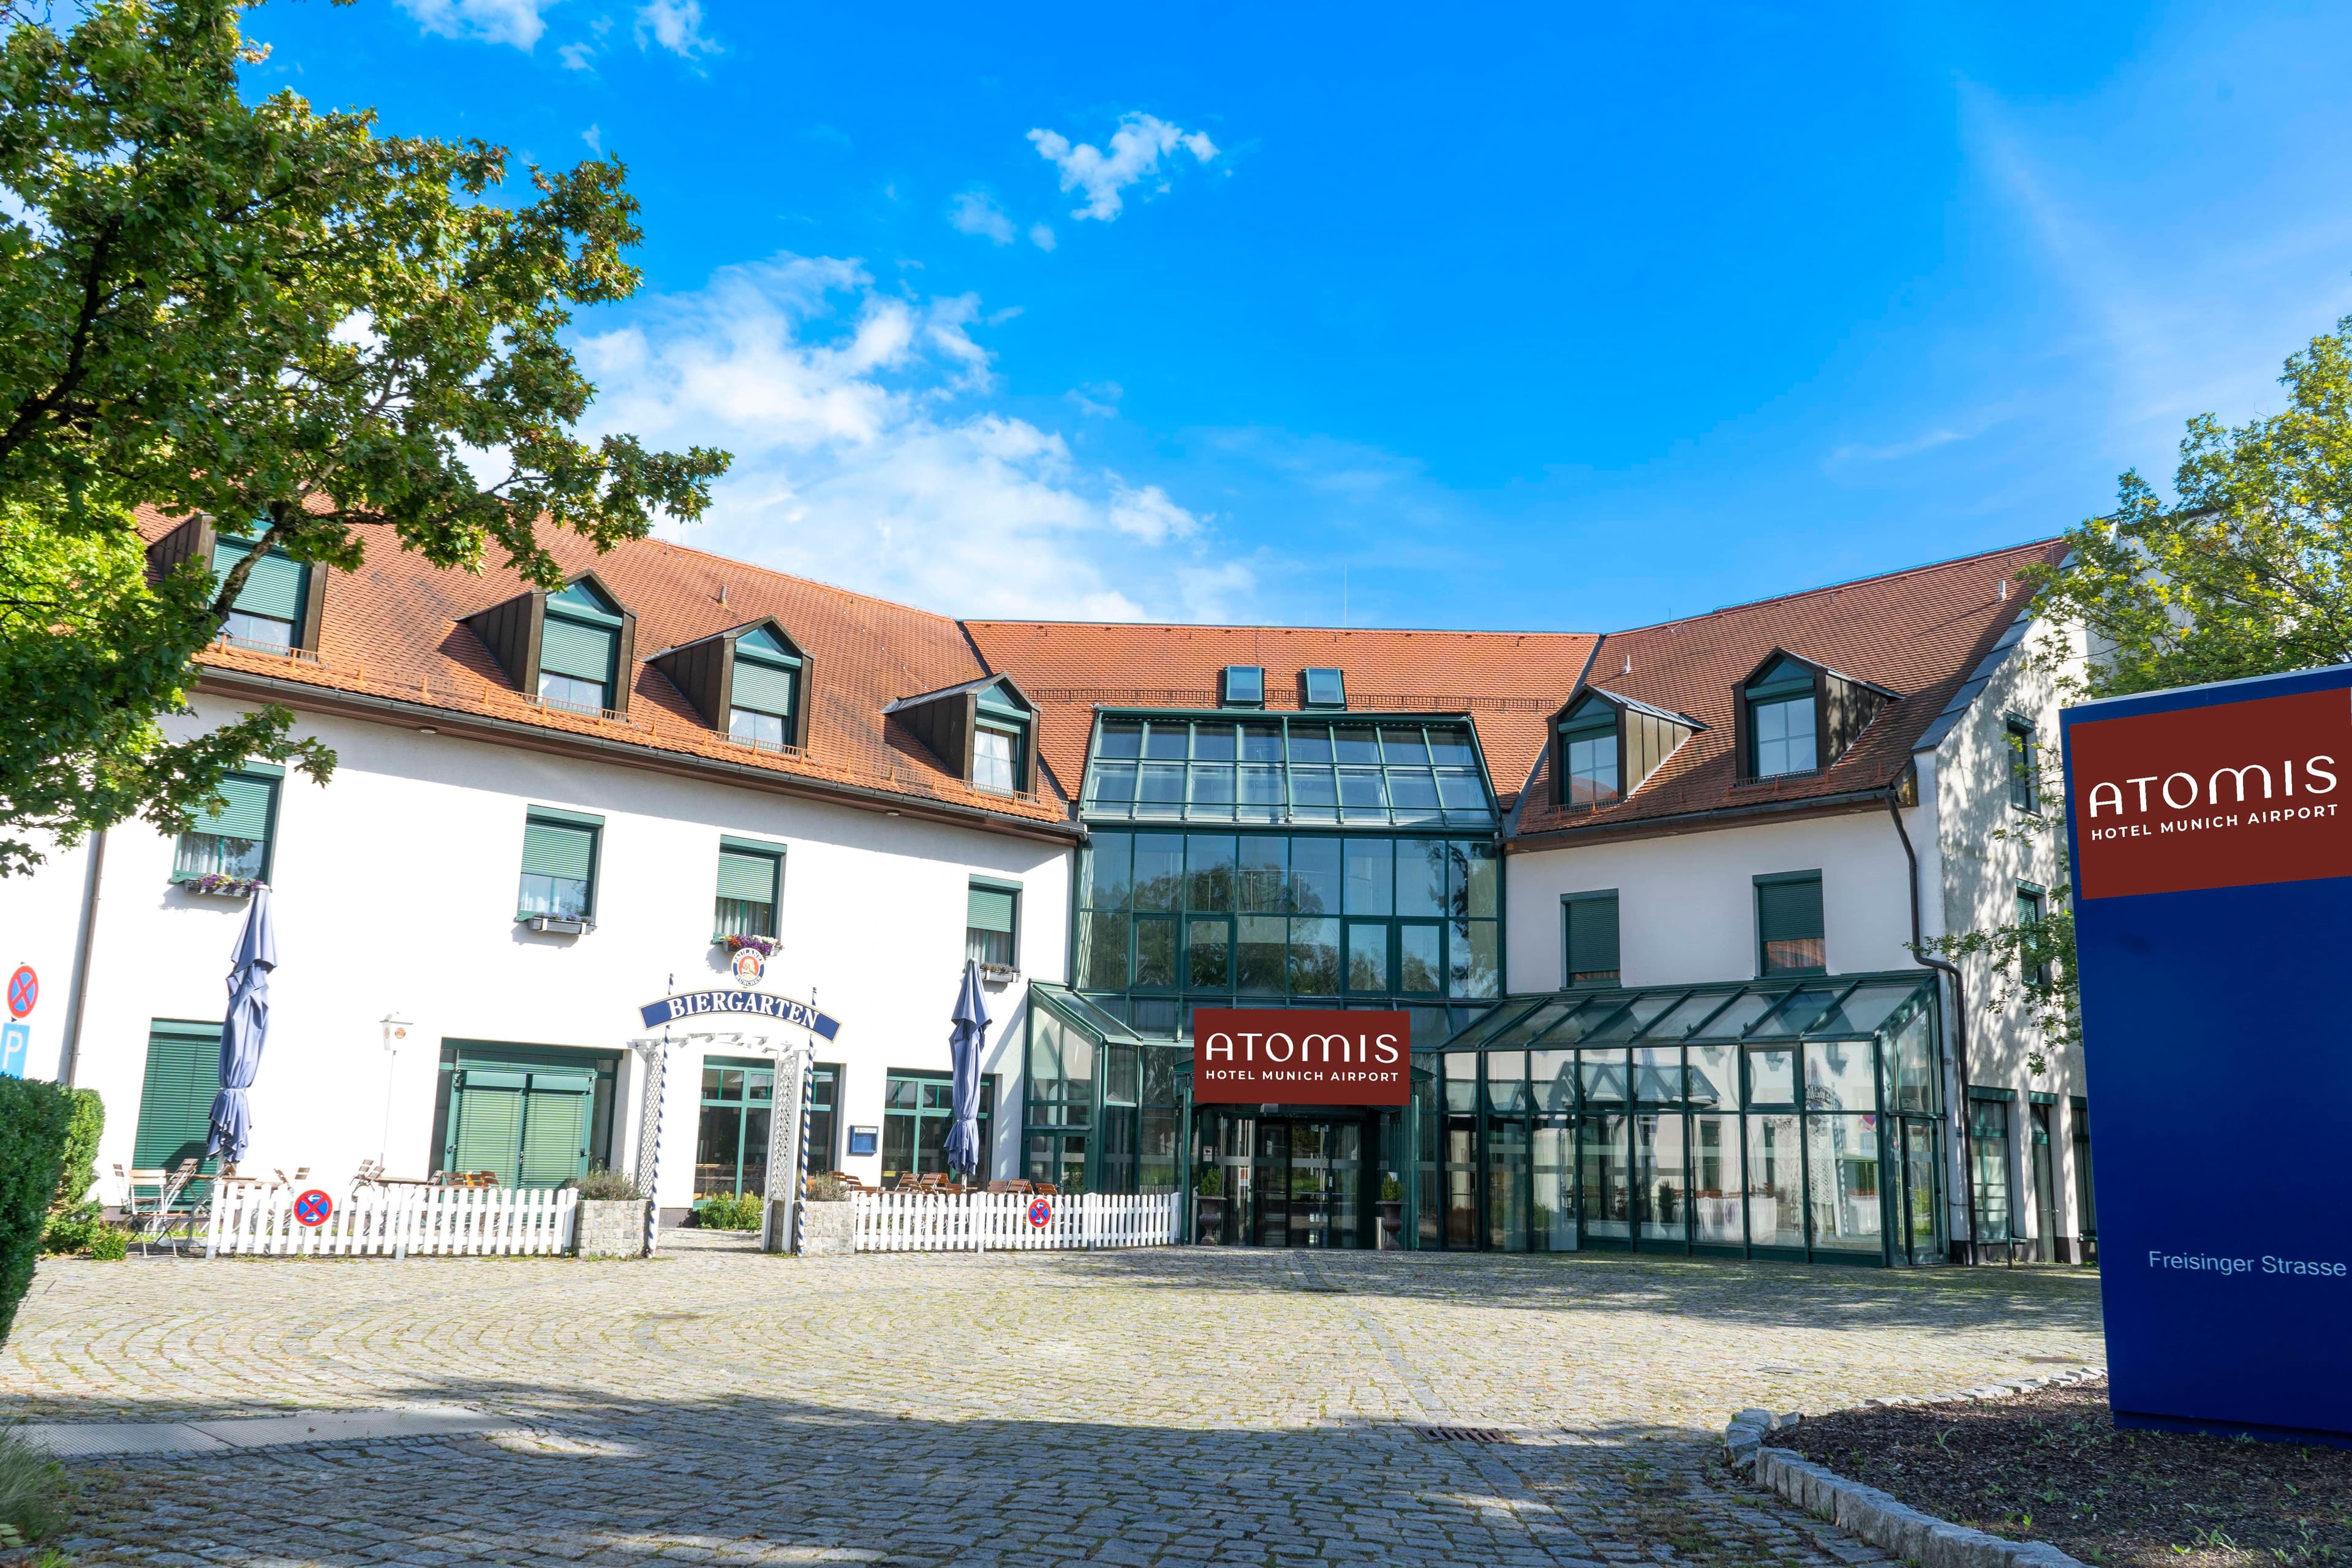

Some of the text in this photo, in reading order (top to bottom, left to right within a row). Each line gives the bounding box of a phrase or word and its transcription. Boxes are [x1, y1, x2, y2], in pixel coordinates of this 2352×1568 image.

[2089, 755, 2337, 818] ATOMIS
[2092, 804, 2338, 841] HOTEL MUNICH AIRPORT
[666, 992, 820, 1029] BIERGARTEN
[2, 1031, 23, 1069] P
[1205, 1033, 1398, 1064] ATOMIS
[1206, 1070, 1398, 1082] HOTEL MUNICH AIRPORT
[2149, 1251, 2346, 1276] Freisinger Strasse
